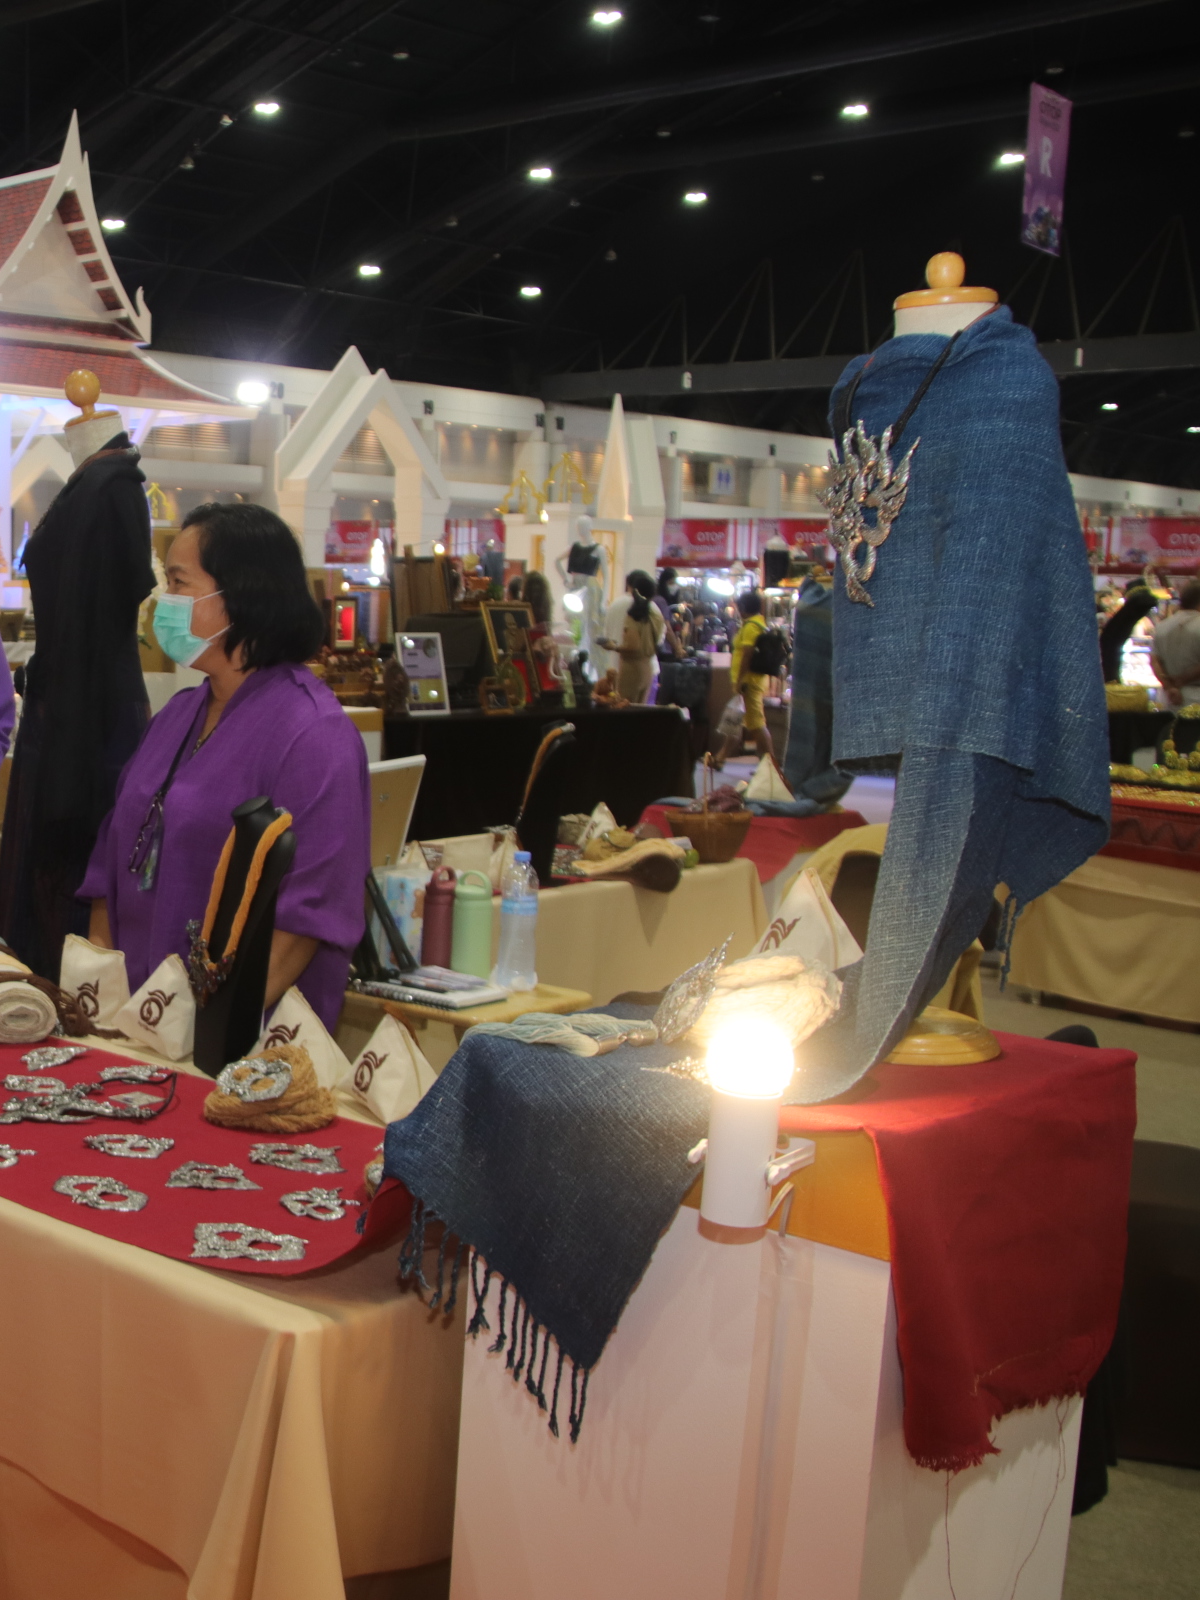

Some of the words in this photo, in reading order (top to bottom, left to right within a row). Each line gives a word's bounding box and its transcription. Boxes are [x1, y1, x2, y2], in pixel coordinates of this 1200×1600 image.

[1039, 135, 1053, 178] R
[270, 381, 284, 399] 20
[1169, 532, 1200, 545] OTO
